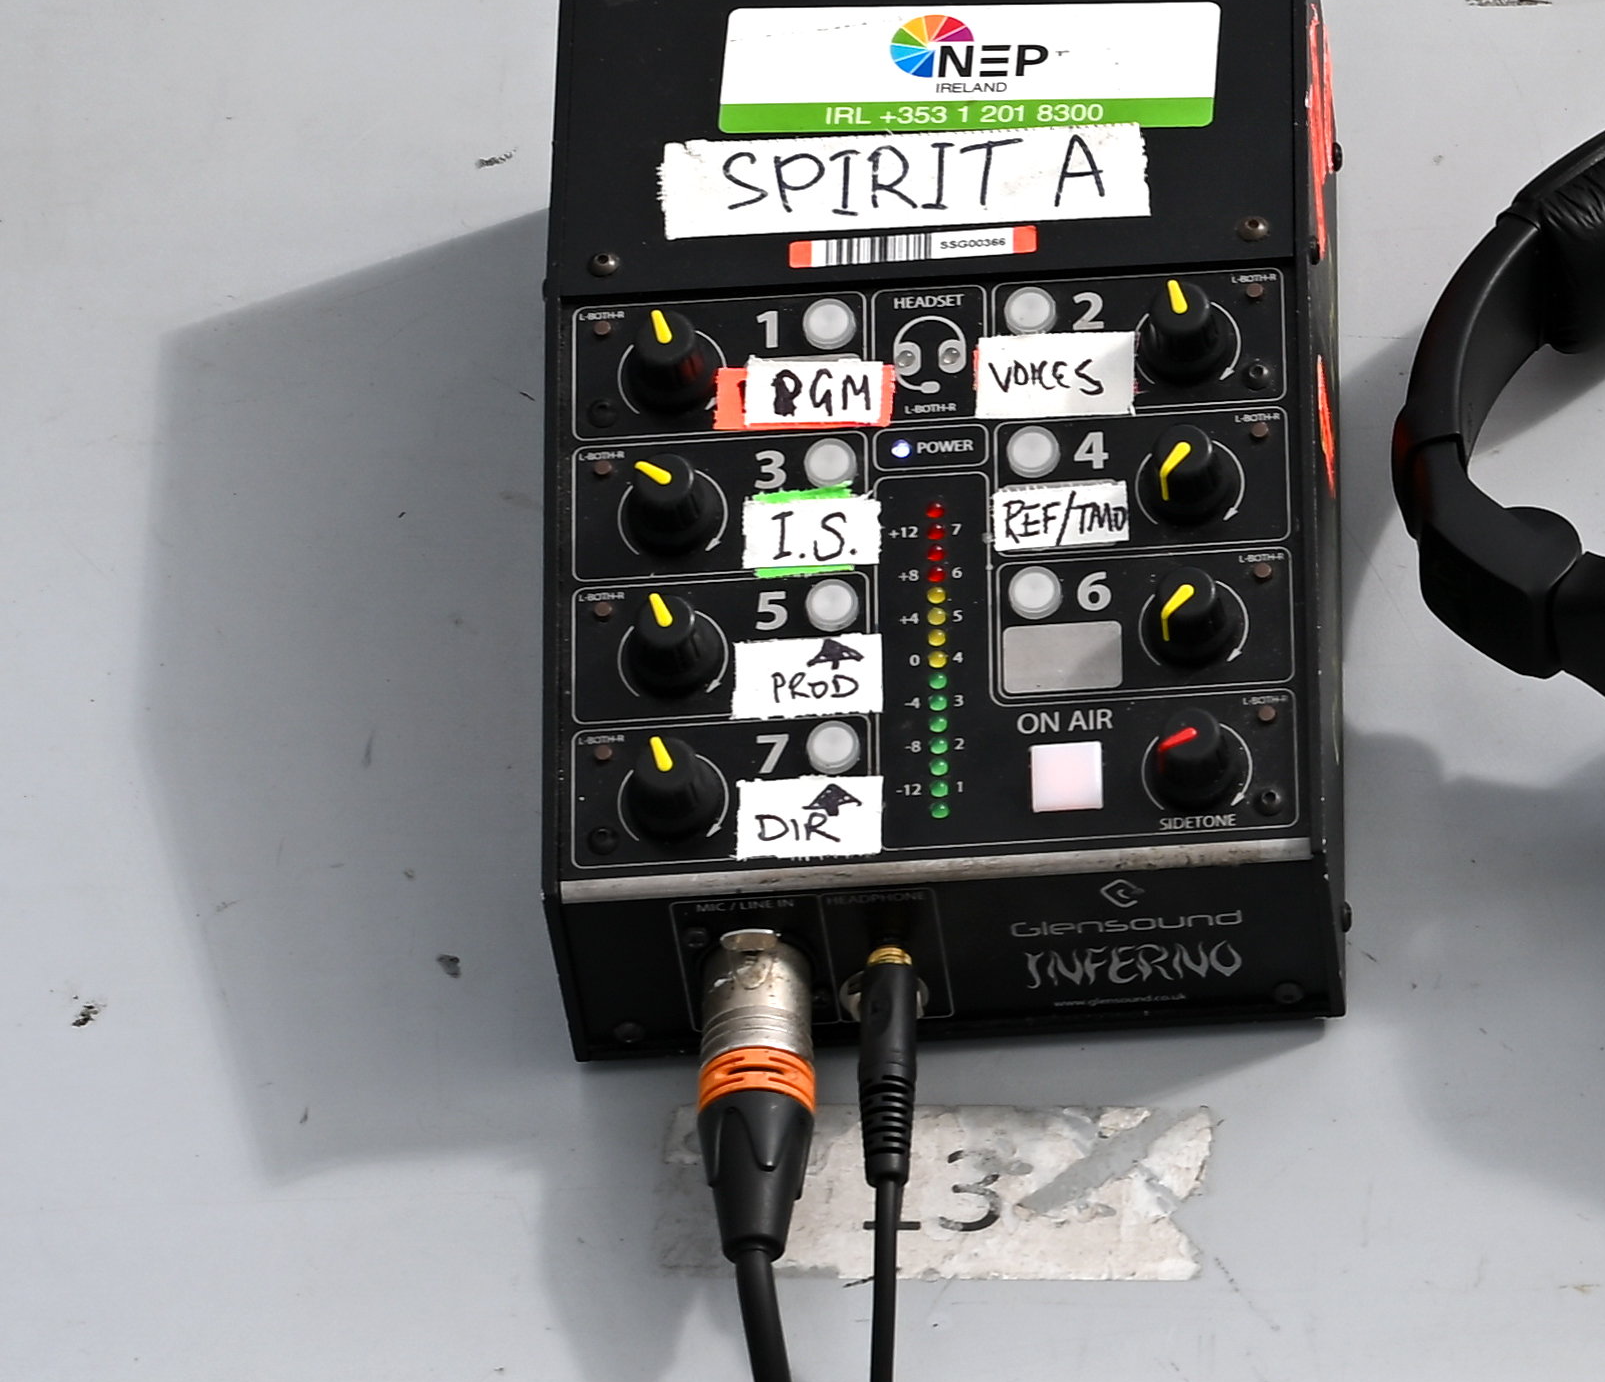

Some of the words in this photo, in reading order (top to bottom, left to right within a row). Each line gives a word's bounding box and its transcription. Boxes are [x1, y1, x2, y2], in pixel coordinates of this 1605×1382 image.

[938, 45, 1048, 77] NEP
[936, 82, 1007, 93] IRELAND
[826, 107, 871, 124] IRL
[880, 106, 947, 124] +353
[958, 106, 968, 122] 1
[980, 105, 1024, 122] 201
[1037, 104, 1103, 121] 8300
[723, 138, 1023, 216] SPIRIT
[1055, 135, 1105, 207] A
[941, 238, 1005, 249] SSG00366
[1232, 273, 1278, 285] L-BOTH-R
[894, 294, 964, 309] HEADSET
[579, 311, 624, 320] L-BOTH-R
[1073, 292, 1104, 330] 2
[757, 311, 778, 348] 1
[905, 403, 956, 414] L-BOTH-R
[1235, 413, 1280, 422] L-BOTH-R
[917, 440, 973, 453] POWER
[1074, 432, 1108, 469] 4
[579, 451, 624, 461] L-BOTH-R
[755, 451, 786, 489] 3
[889, 526, 918, 538] +12
[952, 524, 961, 535] 7
[772, 511, 856, 561] I.S.
[1239, 553, 1284, 563] L-BOTH-R
[899, 570, 919, 581] +8
[952, 567, 962, 578] 6
[578, 592, 625, 603] L-BOTH-R
[1077, 572, 1111, 611] 6
[756, 591, 787, 630] 5
[953, 610, 962, 622] 5
[900, 613, 919, 624] +4
[910, 655, 920, 666] 0
[953, 652, 963, 662] 4
[772, 672, 859, 703] PROD
[905, 698, 920, 708] -4
[954, 695, 963, 706] 3
[1243, 695, 1287, 705] L-BOTH-R
[1017, 712, 1059, 734] ON
[1068, 709, 1112, 731] AIR
[579, 735, 624, 747] L-BOTH-R
[905, 741, 921, 752] -8
[955, 738, 964, 749] 2
[757, 734, 788, 773] 7
[896, 784, 921, 795] -12
[957, 781, 963, 792] 1
[755, 812, 840, 842] DIR
[1160, 814, 1236, 830] SIDETONE
[826, 891, 925, 906] HEADPHONE
[697, 902, 727, 913] MIC
[739, 900, 773, 910] LINE
[777, 899, 795, 907] IN
[1010, 909, 1242, 937] Glensound
[1024, 939, 1242, 989] INFERNO
[1053, 991, 1186, 1007] www.glensound.co.uk
